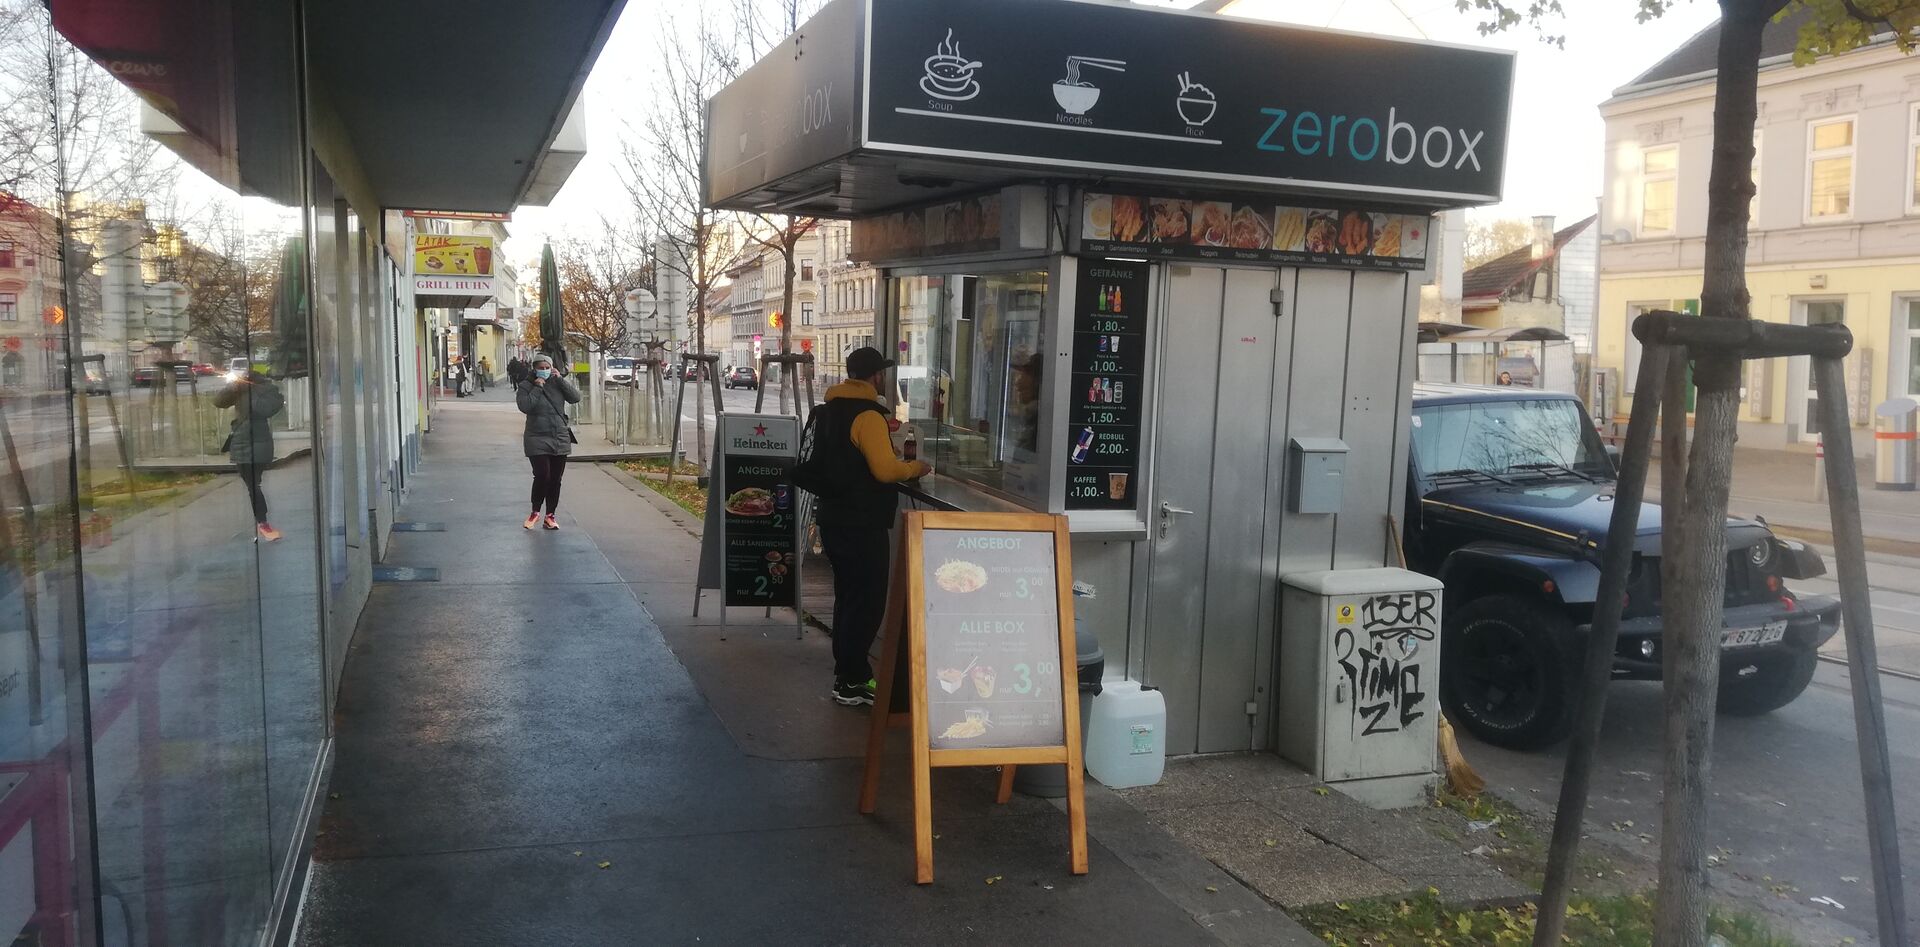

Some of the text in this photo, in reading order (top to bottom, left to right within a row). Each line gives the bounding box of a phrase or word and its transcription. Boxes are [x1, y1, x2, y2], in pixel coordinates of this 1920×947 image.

[928, 100, 953, 112] Soup
[1056, 112, 1093, 126] Noodles
[1185, 126, 1204, 137] Rice
[1257, 106, 1485, 172] zerobox
[416, 280, 490, 290] GRILL HUHN
[733, 438, 788, 450] Heineken
[737, 466, 783, 476] ANGEBOT
[956, 537, 1022, 550] ANGEBOT
[960, 621, 1025, 634] ALLE BOX
